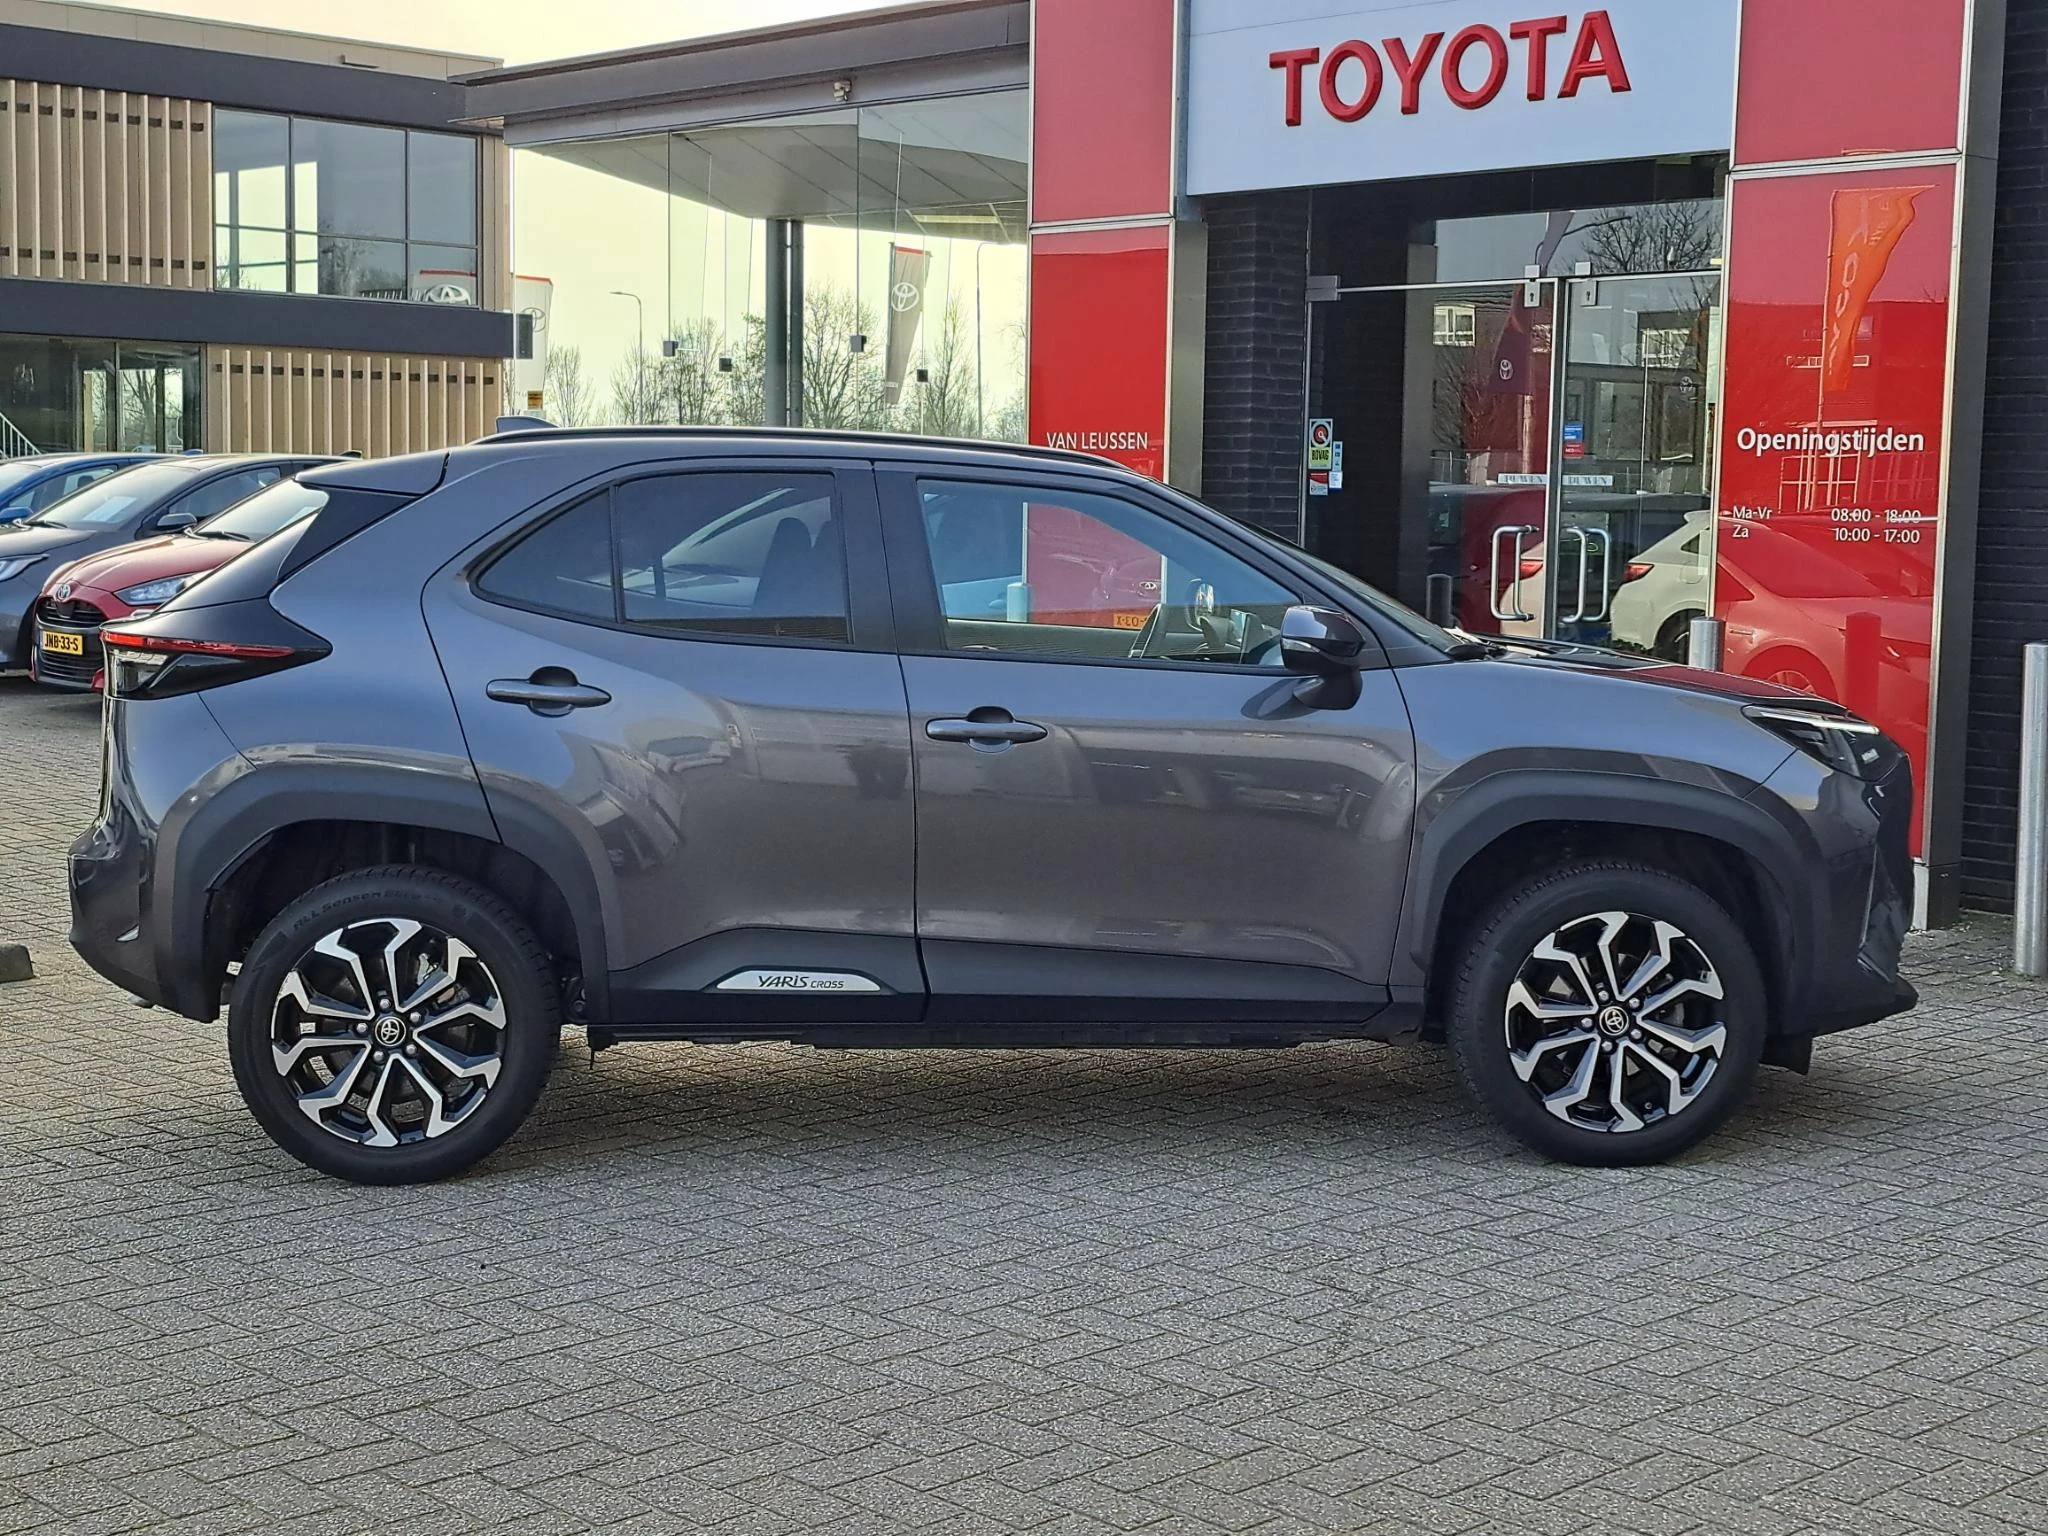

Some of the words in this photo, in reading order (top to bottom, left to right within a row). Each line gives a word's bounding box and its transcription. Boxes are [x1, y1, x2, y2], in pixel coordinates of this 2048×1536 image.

[1269, 10, 1632, 127] TOYOTA
[1046, 432, 1077, 449] VAN
[1081, 432, 1148, 449] LEUSSEN
[1737, 427, 1924, 458] Openingstijden
[1732, 505, 1772, 520] Ma-Vr
[1831, 508, 1871, 522] 08:00
[1884, 509, 1921, 523] 18:00
[1732, 525, 1749, 538] Za
[1835, 528, 1870, 541] 10:00
[1884, 529, 1920, 543] 17:00
[811, 980, 844, 989] CROSS
